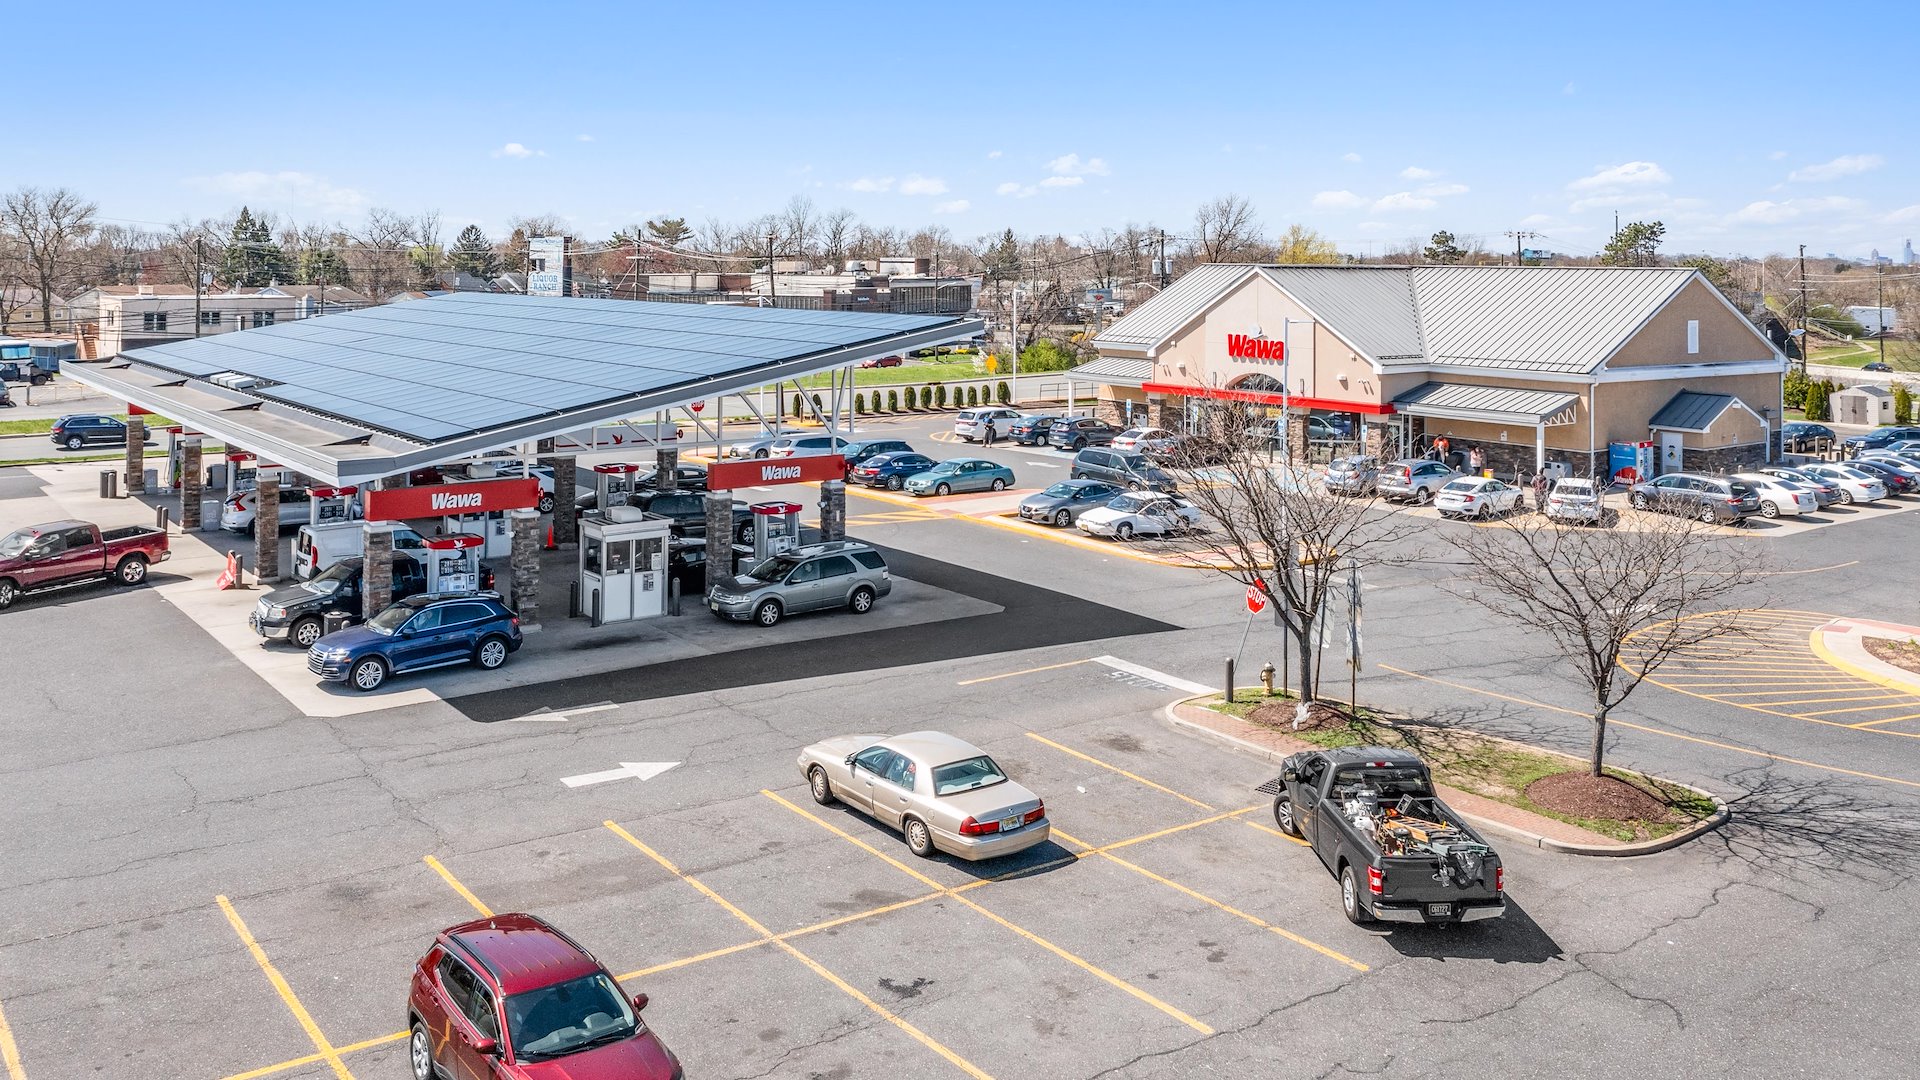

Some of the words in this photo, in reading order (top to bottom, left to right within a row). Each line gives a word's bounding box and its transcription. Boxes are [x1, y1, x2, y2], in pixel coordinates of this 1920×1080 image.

[531, 274, 558, 283] LIQUOR
[533, 282, 558, 291] RANCH
[1227, 333, 1285, 361] Wawa
[761, 465, 802, 481] Wawa
[431, 492, 483, 510] Wawa
[1248, 585, 1267, 606] STOP
